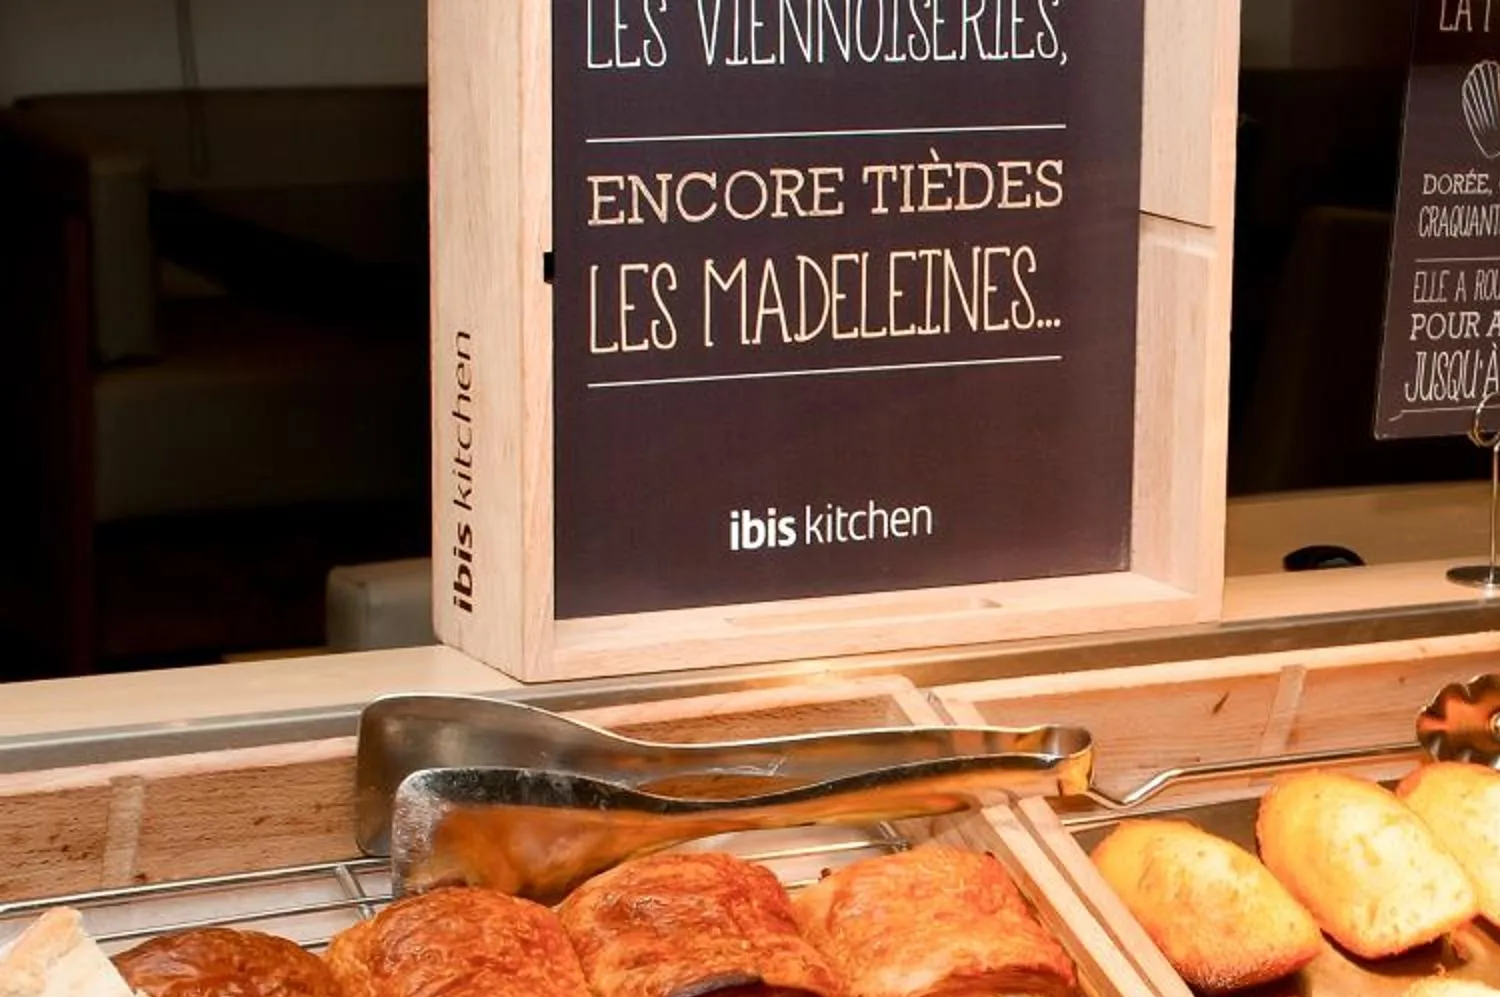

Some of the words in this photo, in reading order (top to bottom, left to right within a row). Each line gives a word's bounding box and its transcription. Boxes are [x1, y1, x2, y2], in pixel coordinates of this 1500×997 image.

[587, 0, 667, 68] LES
[699, 0, 1068, 65] VIENNOISERIES,
[1439, 0, 1472, 32] LA
[587, 167, 845, 226] ENCORE
[862, 147, 1064, 215] TIÈDES
[1422, 169, 1493, 196] DORÉE,
[590, 262, 677, 353] LES
[704, 245, 1062, 347] MADELEINES...
[1413, 269, 1450, 303] ELLE
[1455, 271, 1467, 302] A
[1410, 311, 1480, 341] POUR
[1404, 342, 1500, 404] JUSQU'À
[452, 331, 472, 511] kitchen
[730, 507, 797, 550] ibis
[805, 500, 932, 545] kitchen
[453, 522, 473, 613] ibis
